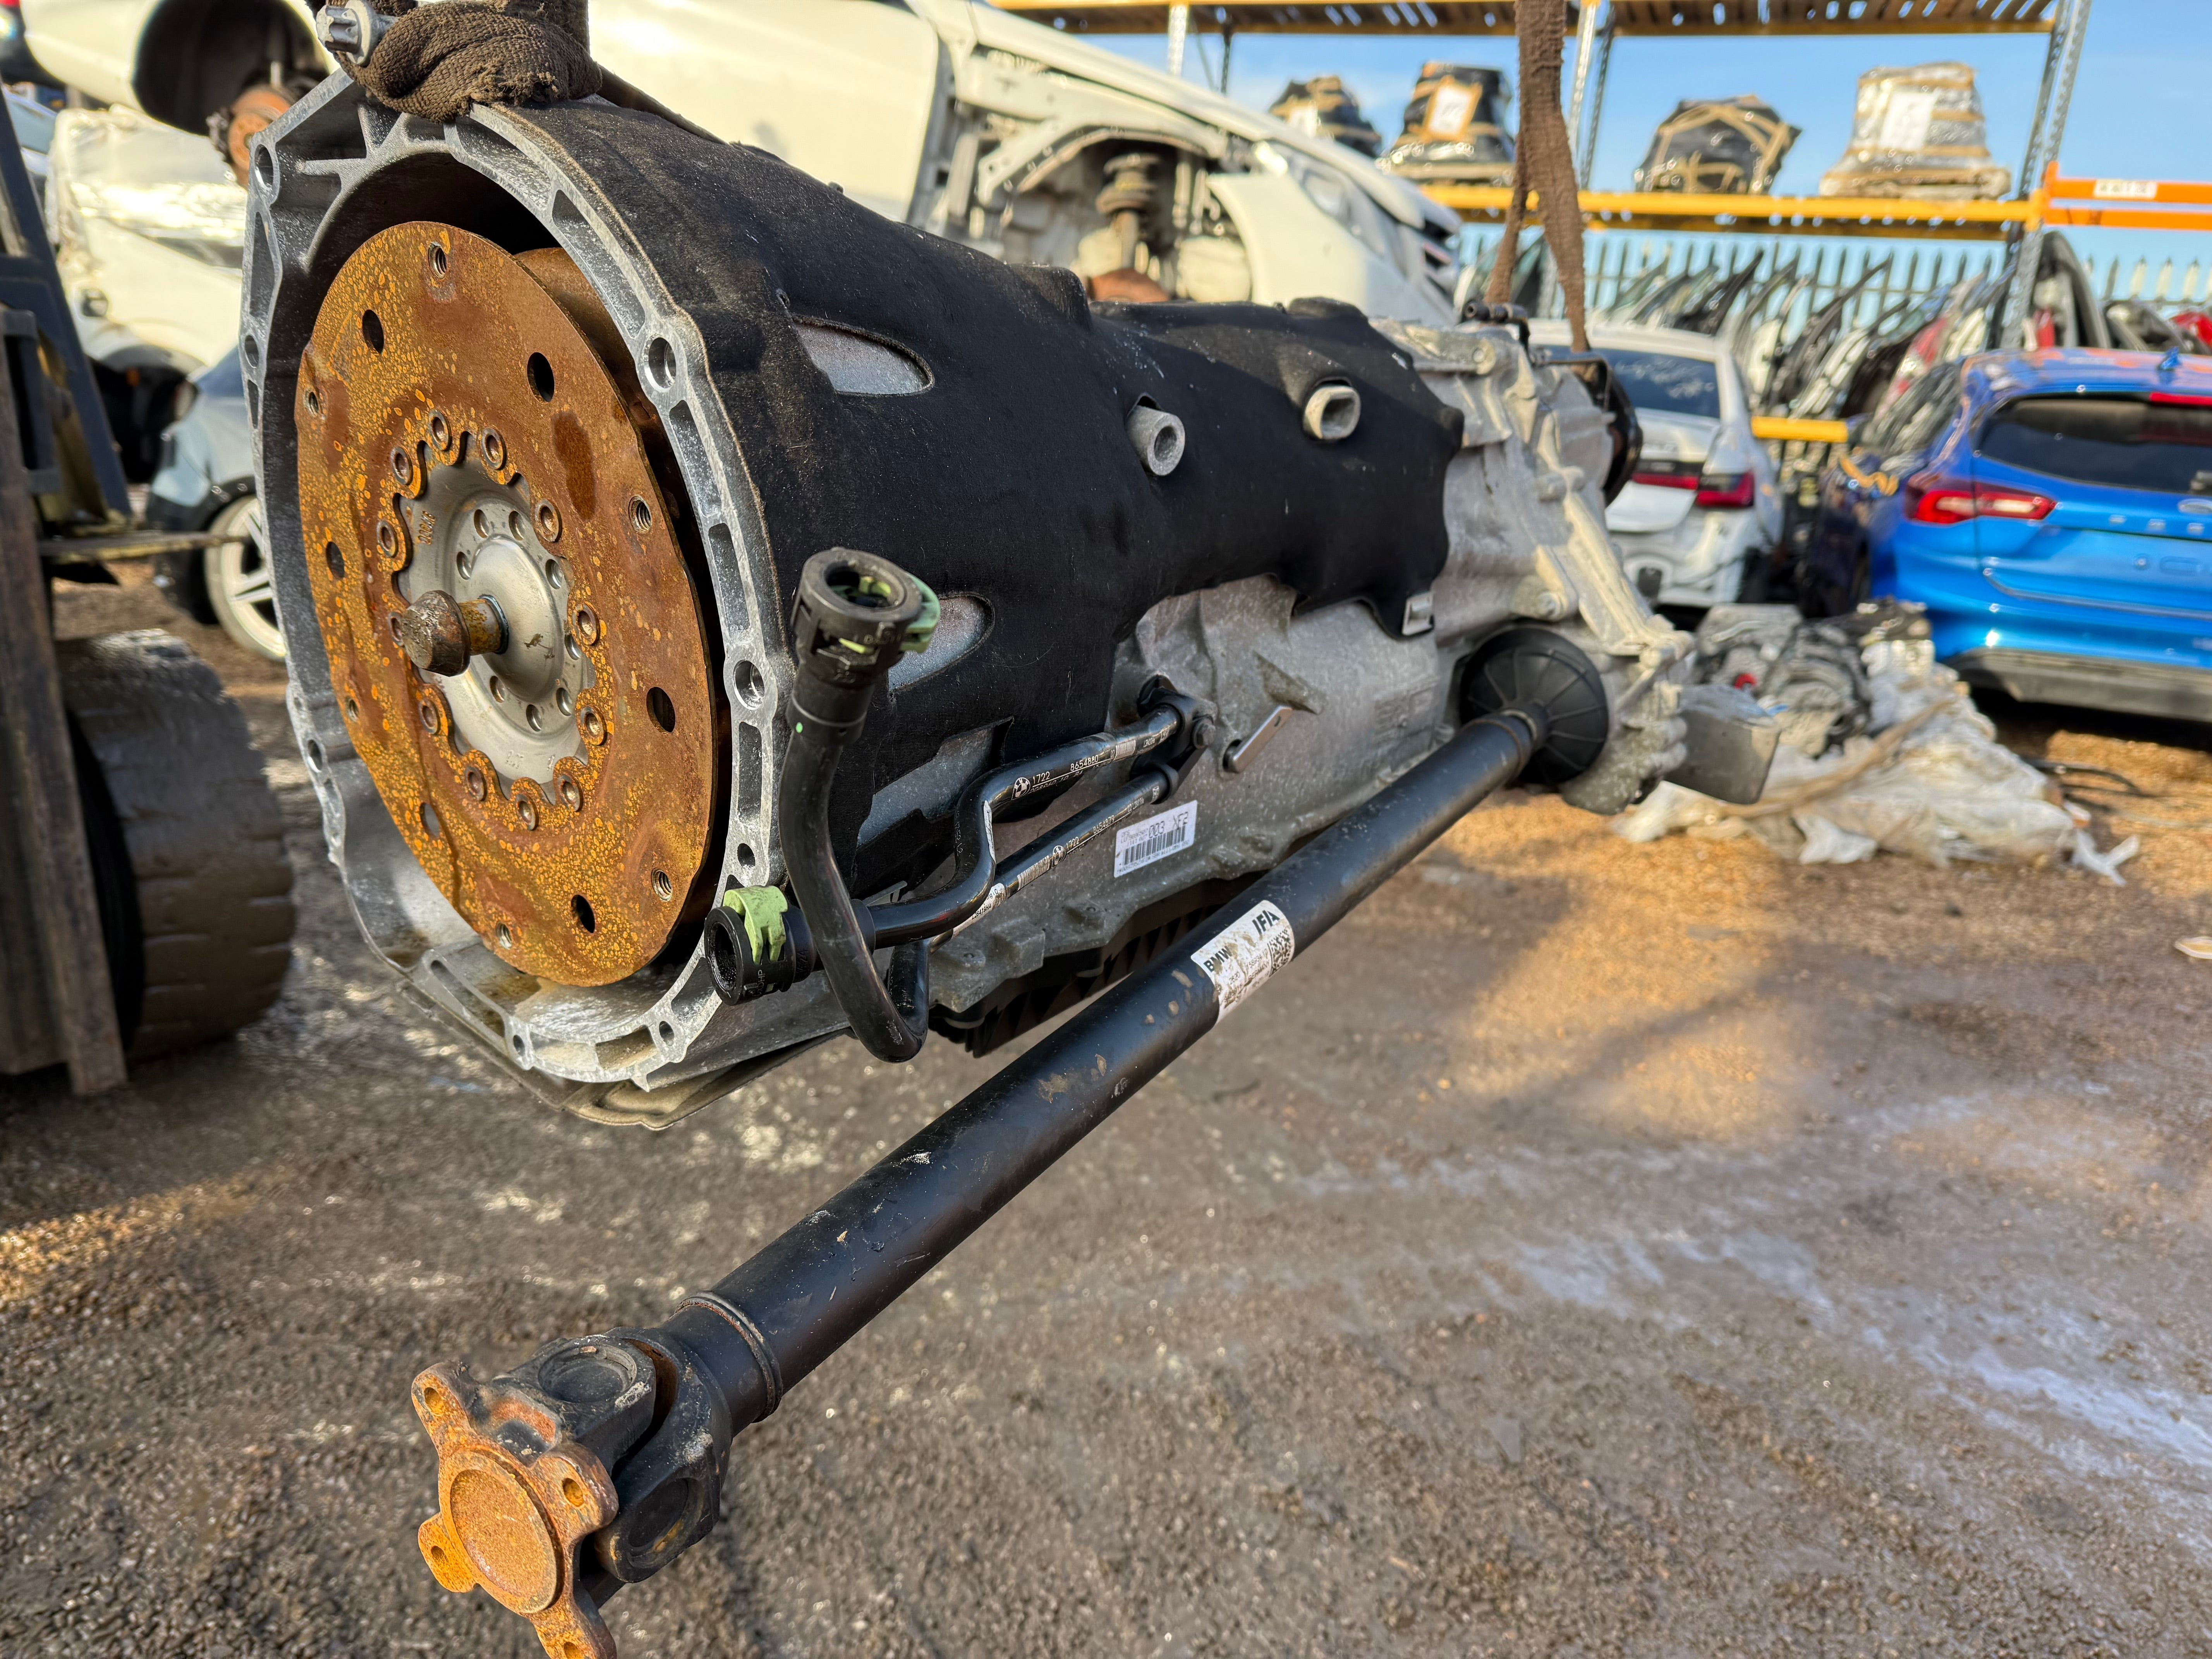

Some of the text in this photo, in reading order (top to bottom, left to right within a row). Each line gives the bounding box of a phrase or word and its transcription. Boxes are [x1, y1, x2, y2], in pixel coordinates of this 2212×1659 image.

[1033, 771, 1050, 784] 1722
[1070, 755, 1099, 771] 8654880
[1066, 836, 1079, 850] 1722
[1093, 815, 1115, 834] 8654879
[1149, 821, 1165, 838] 003
[1252, 910, 1280, 935] IFA
[1204, 945, 1232, 972] BMW
